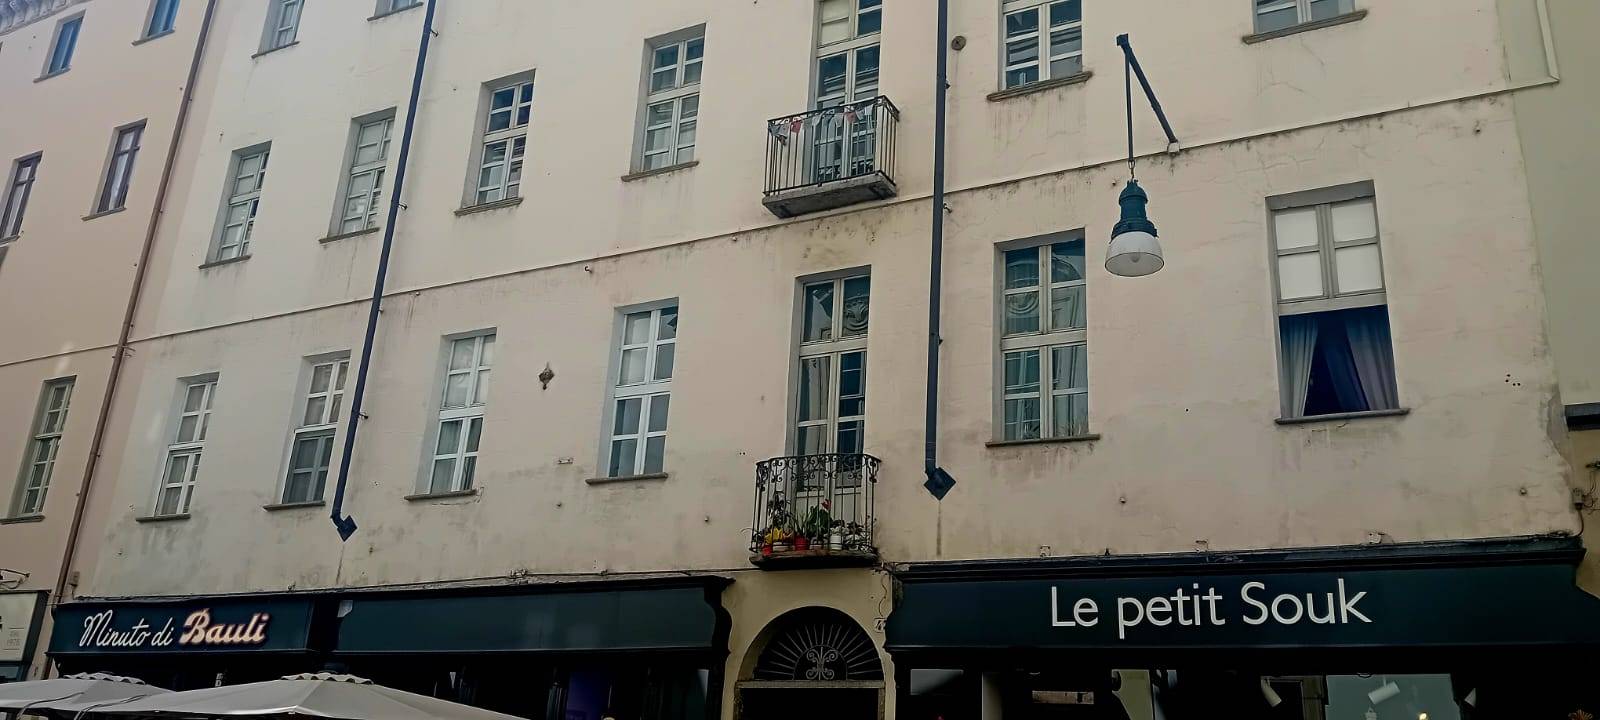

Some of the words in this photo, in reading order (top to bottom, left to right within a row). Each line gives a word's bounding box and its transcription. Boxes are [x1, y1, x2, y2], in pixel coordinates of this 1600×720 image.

[79, 609, 151, 647] Minuto
[151, 616, 175, 647] di
[178, 607, 270, 645] Bauli
[1051, 586, 1099, 627] Le
[1117, 582, 1226, 640] petit
[1240, 578, 1373, 625] Souk
